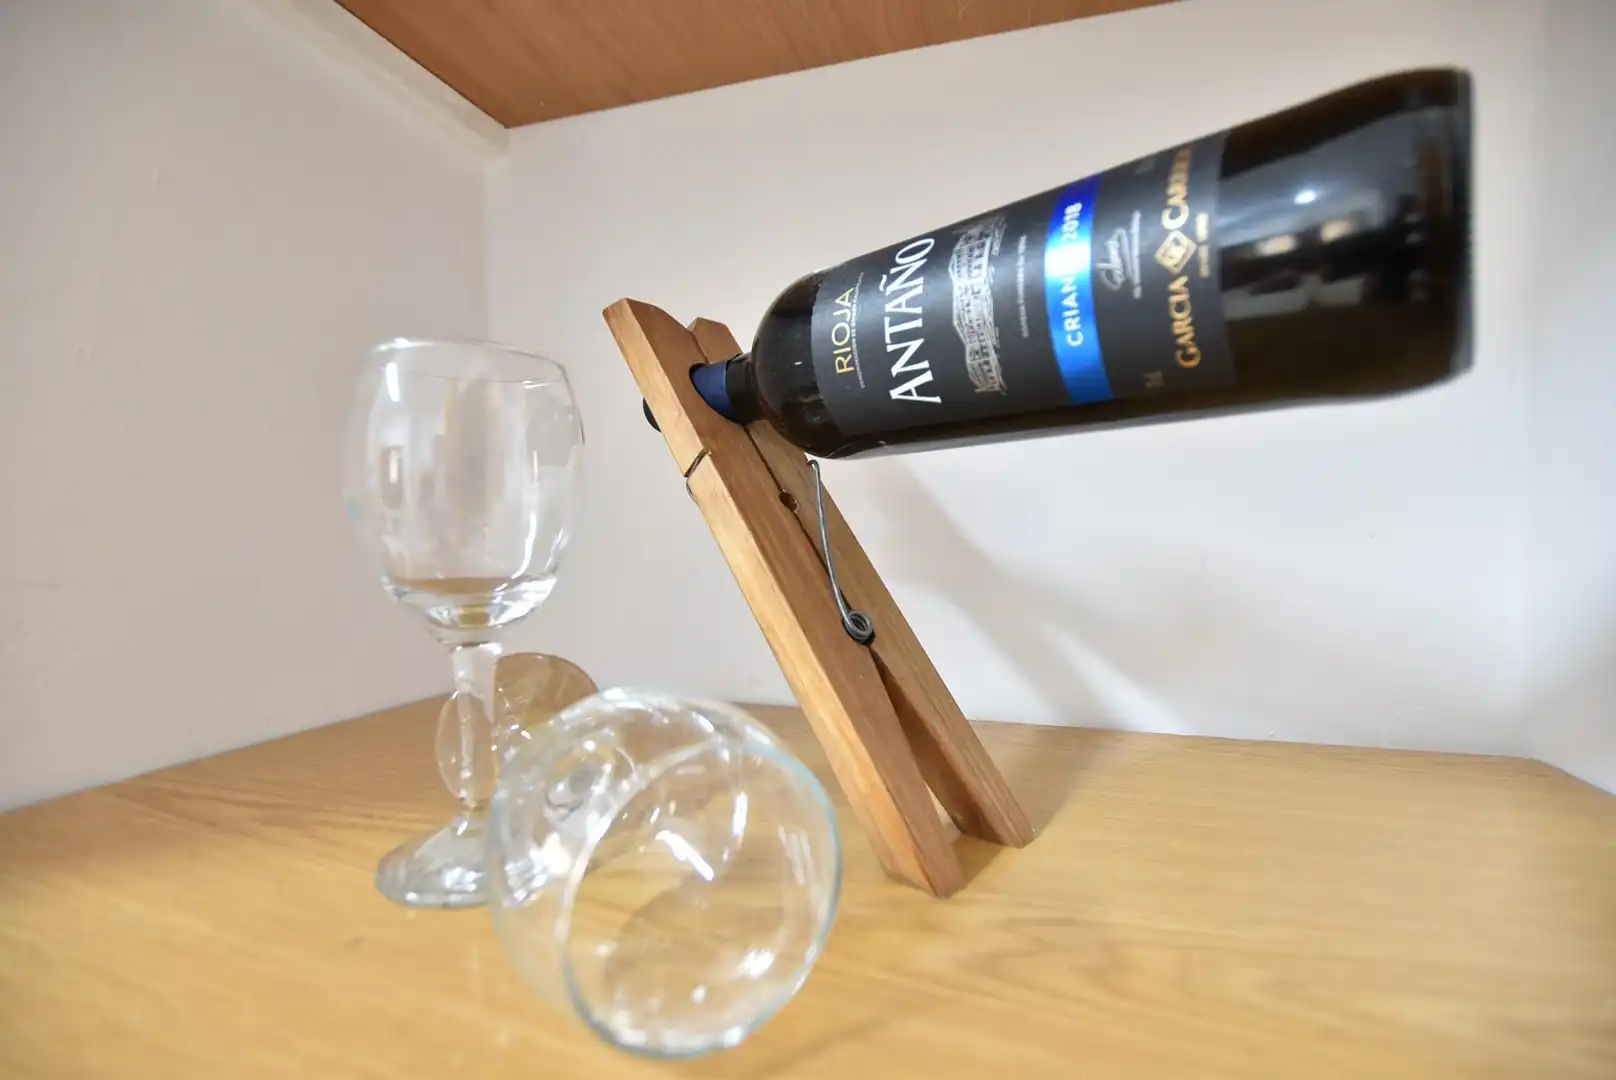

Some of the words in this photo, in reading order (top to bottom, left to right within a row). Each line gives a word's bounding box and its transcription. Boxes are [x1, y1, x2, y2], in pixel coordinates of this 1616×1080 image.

[1061, 202, 1083, 241] 2018
[832, 287, 855, 374] RIOJA
[879, 238, 942, 403] ANTAÑO
[1061, 275, 1084, 347] CRIAN
[1168, 275, 1201, 368] GARCIA
